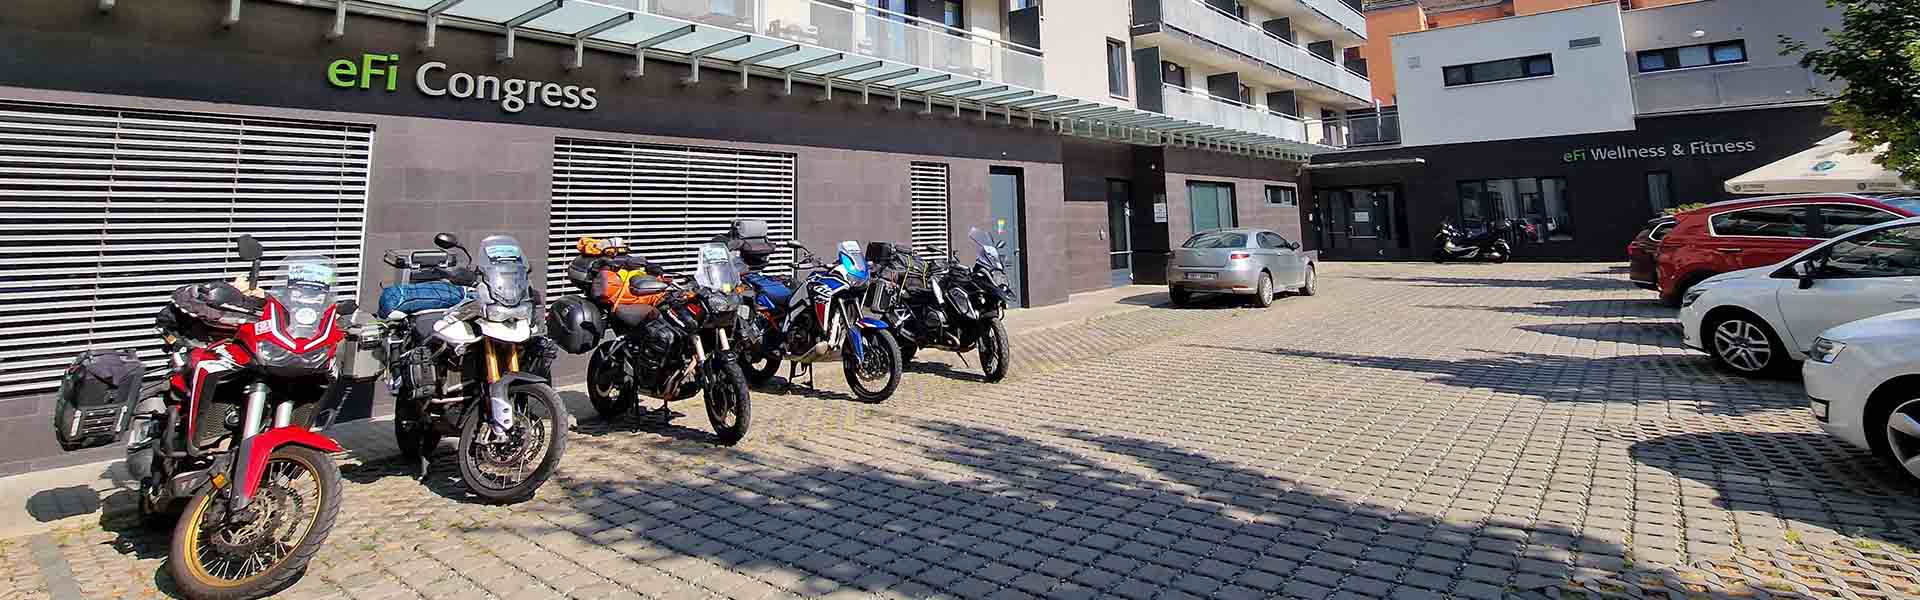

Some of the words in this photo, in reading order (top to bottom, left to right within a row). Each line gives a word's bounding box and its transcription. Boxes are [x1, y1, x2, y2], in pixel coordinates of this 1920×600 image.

[327, 53, 400, 91] eFi
[415, 61, 598, 112] Congress
[1563, 149, 1586, 162] eFi
[1590, 145, 1666, 161] Wellness
[1672, 143, 1685, 156] &
[1689, 140, 1756, 155] Fitness
